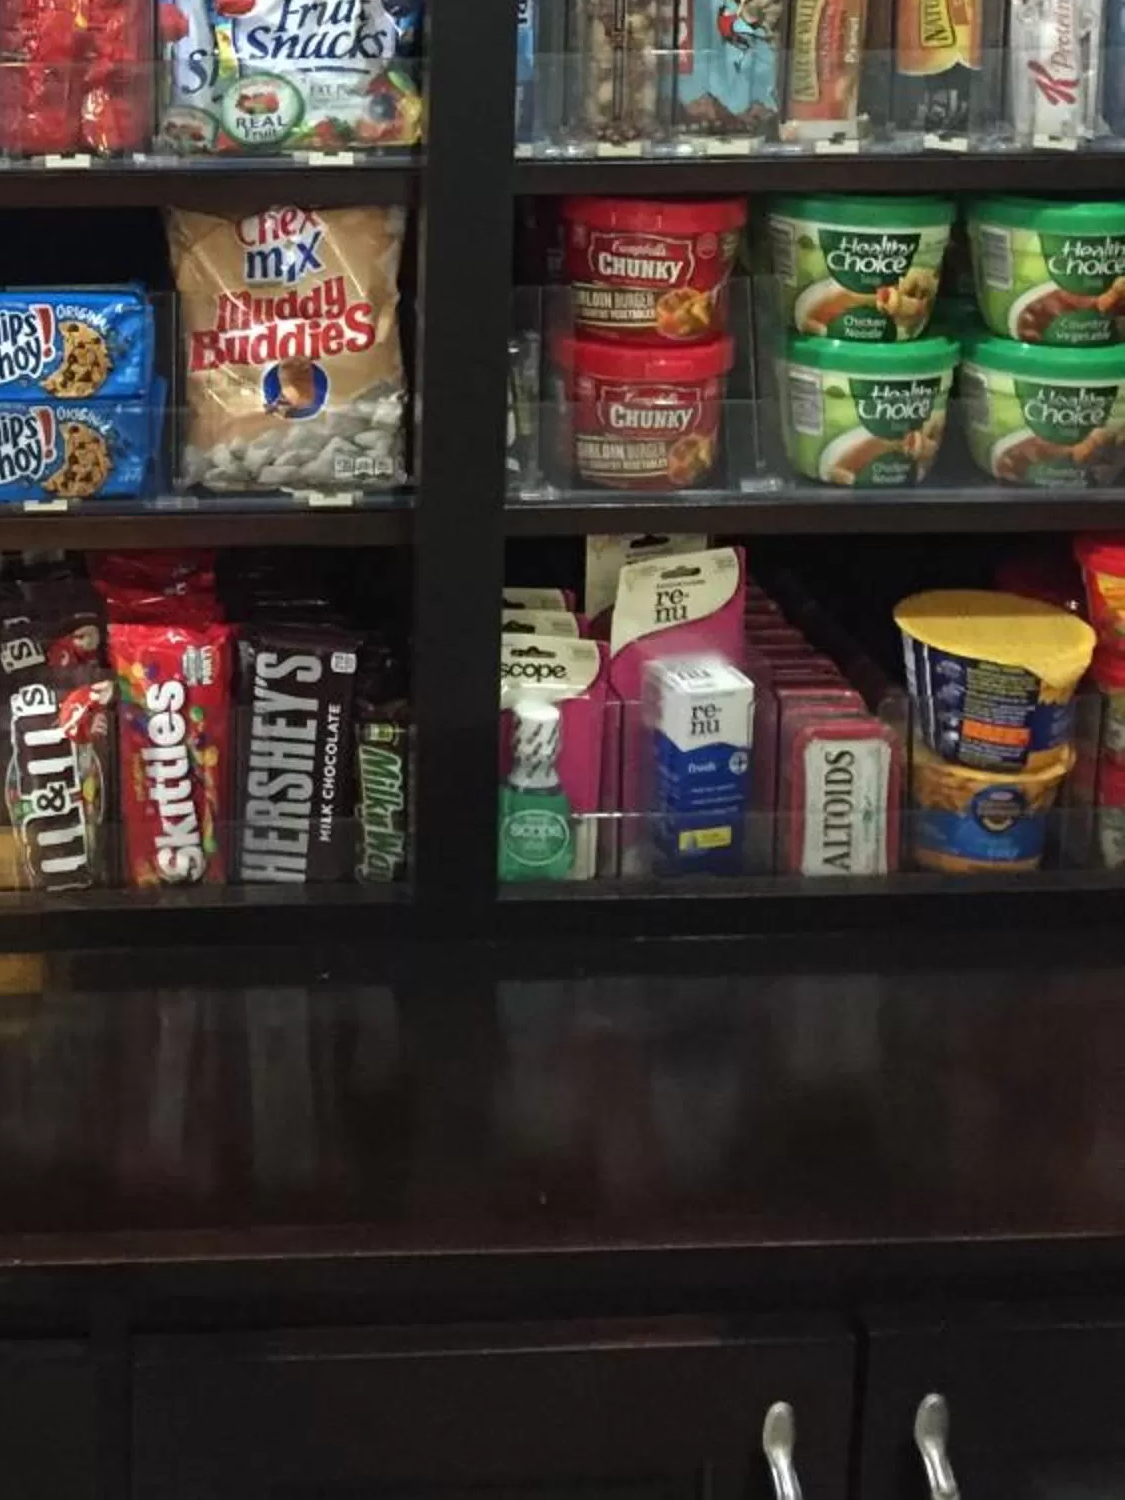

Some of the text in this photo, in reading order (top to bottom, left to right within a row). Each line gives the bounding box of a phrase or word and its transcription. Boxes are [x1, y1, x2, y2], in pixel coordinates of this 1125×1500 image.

[246, 19, 387, 60] Snacks
[236, 116, 288, 130] REAL
[245, 231, 324, 283] mix
[840, 235, 915, 258] Healthy
[598, 254, 684, 283] CHUNKY
[827, 249, 909, 274] Choice
[1048, 250, 1125, 276] Choice
[216, 276, 348, 333] Muddy
[614, 292, 655, 308] BURGER
[844, 316, 887, 328] Chicken
[189, 301, 376, 372] Buddies
[872, 380, 937, 401] Healthy
[610, 403, 694, 432] CHUNKY
[858, 398, 932, 421] Choice
[1025, 402, 1106, 425] Choice
[655, 588, 689, 606] re-
[655, 606, 688, 624] nu
[501, 664, 567, 683] scope
[691, 703, 723, 719] re-
[691, 720, 720, 736] nu
[241, 652, 323, 883] HERSHEY'S
[320, 703, 342, 842] MILK CHOCOLATE
[140, 680, 206, 882] Skittles
[822, 749, 856, 872] ALTOIDS
